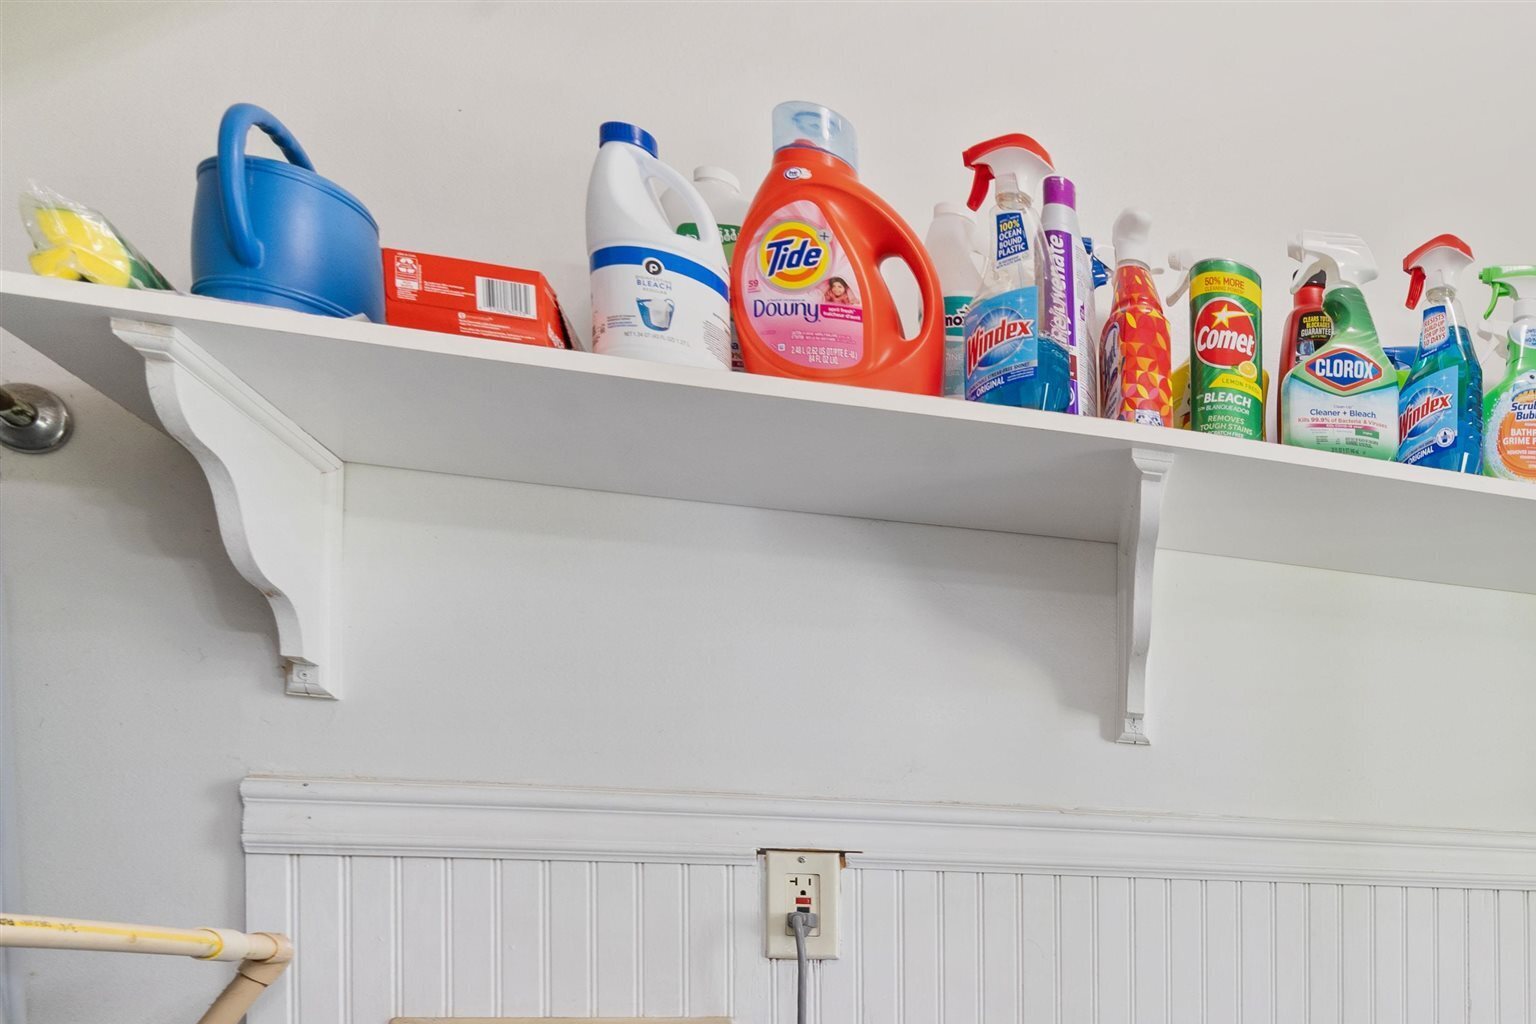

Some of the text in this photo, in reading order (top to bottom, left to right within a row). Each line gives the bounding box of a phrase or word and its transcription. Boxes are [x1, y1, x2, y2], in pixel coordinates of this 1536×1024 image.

[1000, 219, 1020, 232] 100%
[999, 227, 1022, 241] OCEAN
[999, 236, 1022, 249] BOUND
[999, 242, 1025, 258] PLASTIC
[766, 238, 822, 277] Tide
[637, 280, 672, 290] BLEACH
[1205, 276, 1245, 289] 50% MORE
[753, 299, 819, 323] Downy
[1424, 313, 1445, 326] RESISTS
[1301, 328, 1331, 337] GUARANTEE
[1431, 333, 1446, 343] DAYS
[1197, 325, 1254, 356] Comet
[967, 317, 1034, 379] Windex
[1315, 358, 1373, 379] CLOROX
[976, 376, 1005, 397] ORIGINAL
[1222, 378, 1243, 387] LEMON
[1204, 391, 1251, 408] BLEACH
[1206, 404, 1249, 415] BLANQUEADOR
[1350, 409, 1376, 418] Bleach
[1208, 415, 1245, 425] REMOVES
[1399, 394, 1452, 446] Windex
[1200, 423, 1253, 435] TOUGH STAINS
[1502, 436, 1530, 445] GRIME
[1408, 446, 1434, 465] ORIGINAL
